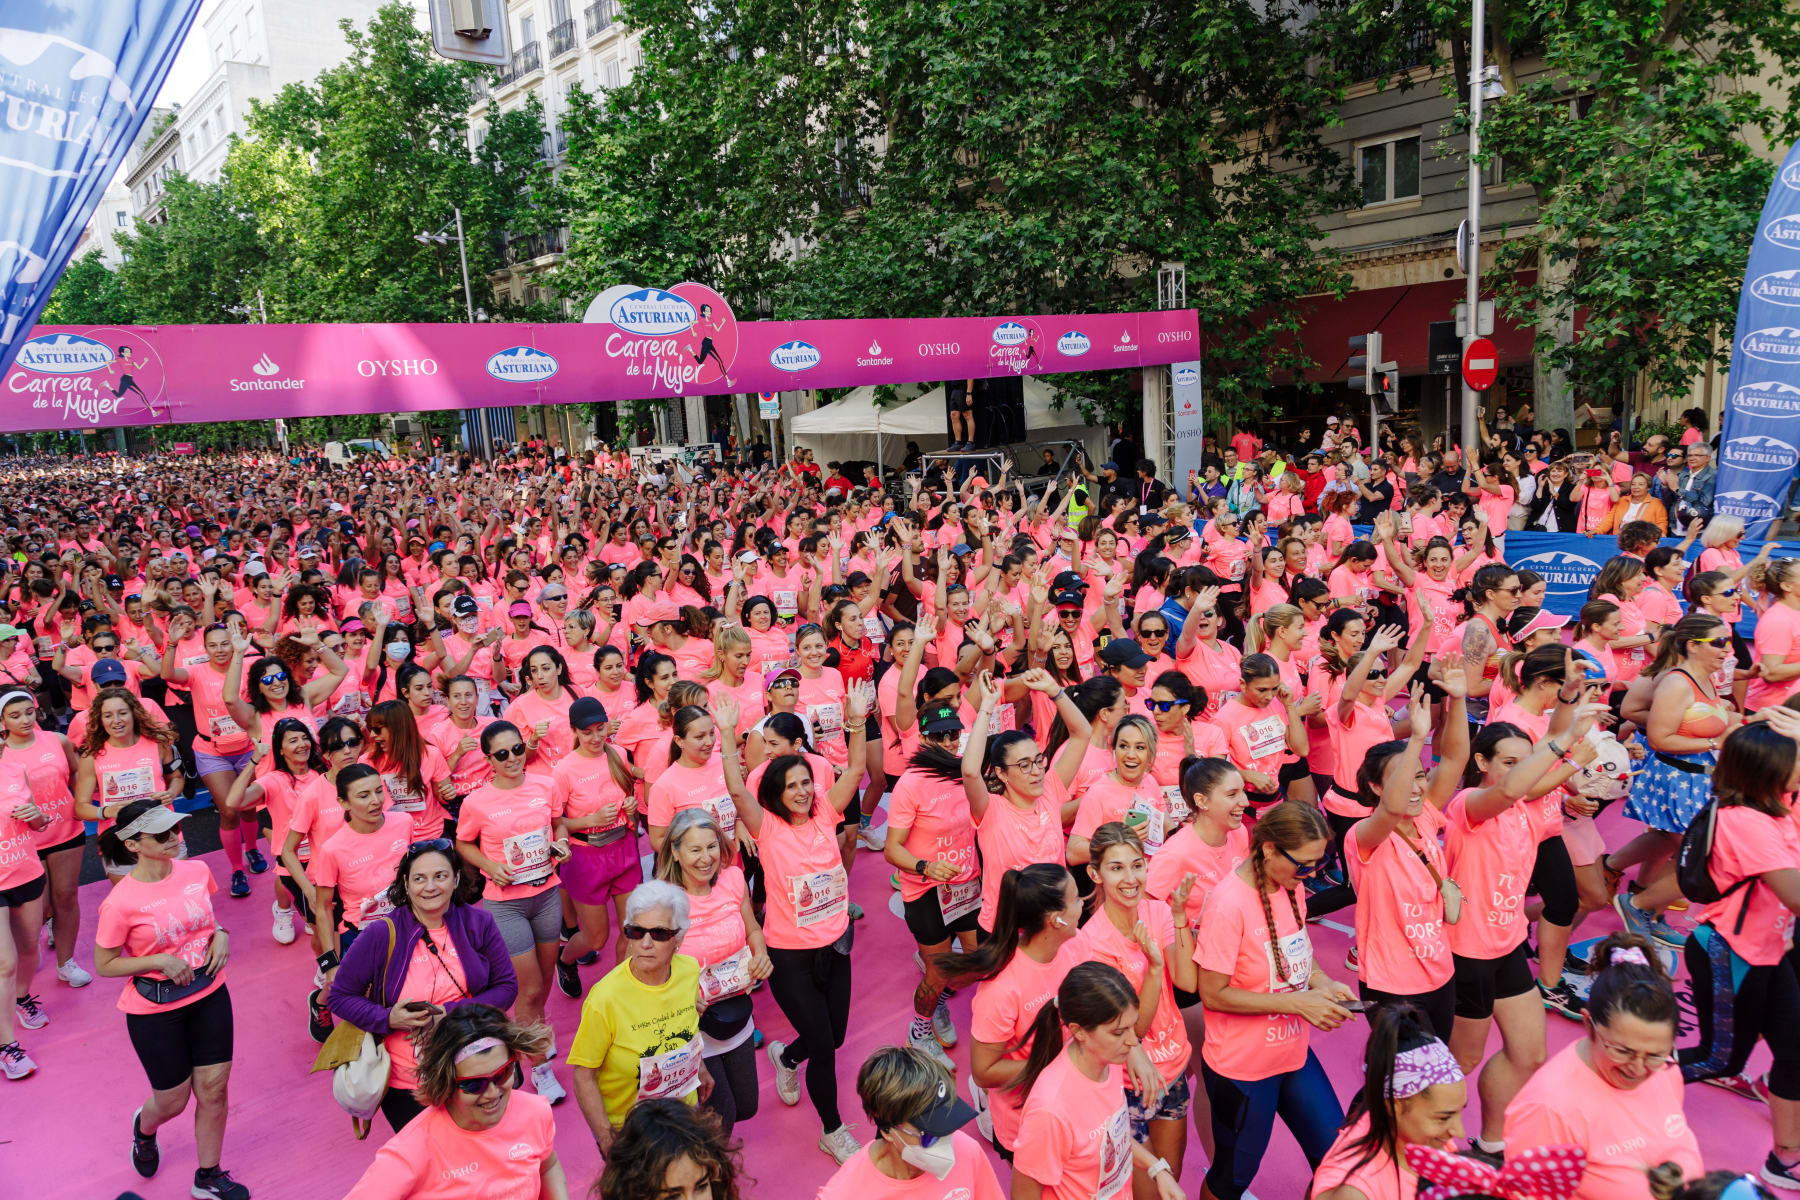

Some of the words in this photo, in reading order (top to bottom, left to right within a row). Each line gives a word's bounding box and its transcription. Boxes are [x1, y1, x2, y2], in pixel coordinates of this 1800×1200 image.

[618, 305, 692, 324] ASTURIANA
[1157, 330, 1192, 343] OYSHO
[606, 333, 678, 357] Carrera
[918, 342, 960, 357] OYSHO
[990, 344, 1020, 358] Carrera
[1113, 344, 1139, 353] Santander
[23, 348, 107, 364] ASTURIANA
[774, 352, 817, 365] ASTURIANA
[857, 356, 894, 367] Santander
[357, 358, 438, 377] OYSHO
[493, 359, 554, 374] ASTURIANA
[1008, 354, 1031, 374] Mujer
[626, 358, 640, 376] de
[643, 356, 653, 375] la
[652, 354, 705, 394] Mujer
[8, 371, 94, 393] Carrera
[230, 378, 306, 391] Santander
[33, 393, 49, 409] de
[52, 393, 64, 408] la
[63, 388, 126, 423] Mujer
[1177, 427, 1202, 440] OYSHO
[119, 783, 138, 792] 016
[936, 836, 952, 848] TU
[0, 848, 28, 864] UMA
[525, 847, 545, 858] 016
[814, 886, 831, 899] 016
[953, 886, 969, 898] 016
[1404, 903, 1423, 918] TU
[721, 975, 740, 988] 016
[1023, 991, 1051, 1011] OYSHO
[663, 1067, 686, 1082] 016
